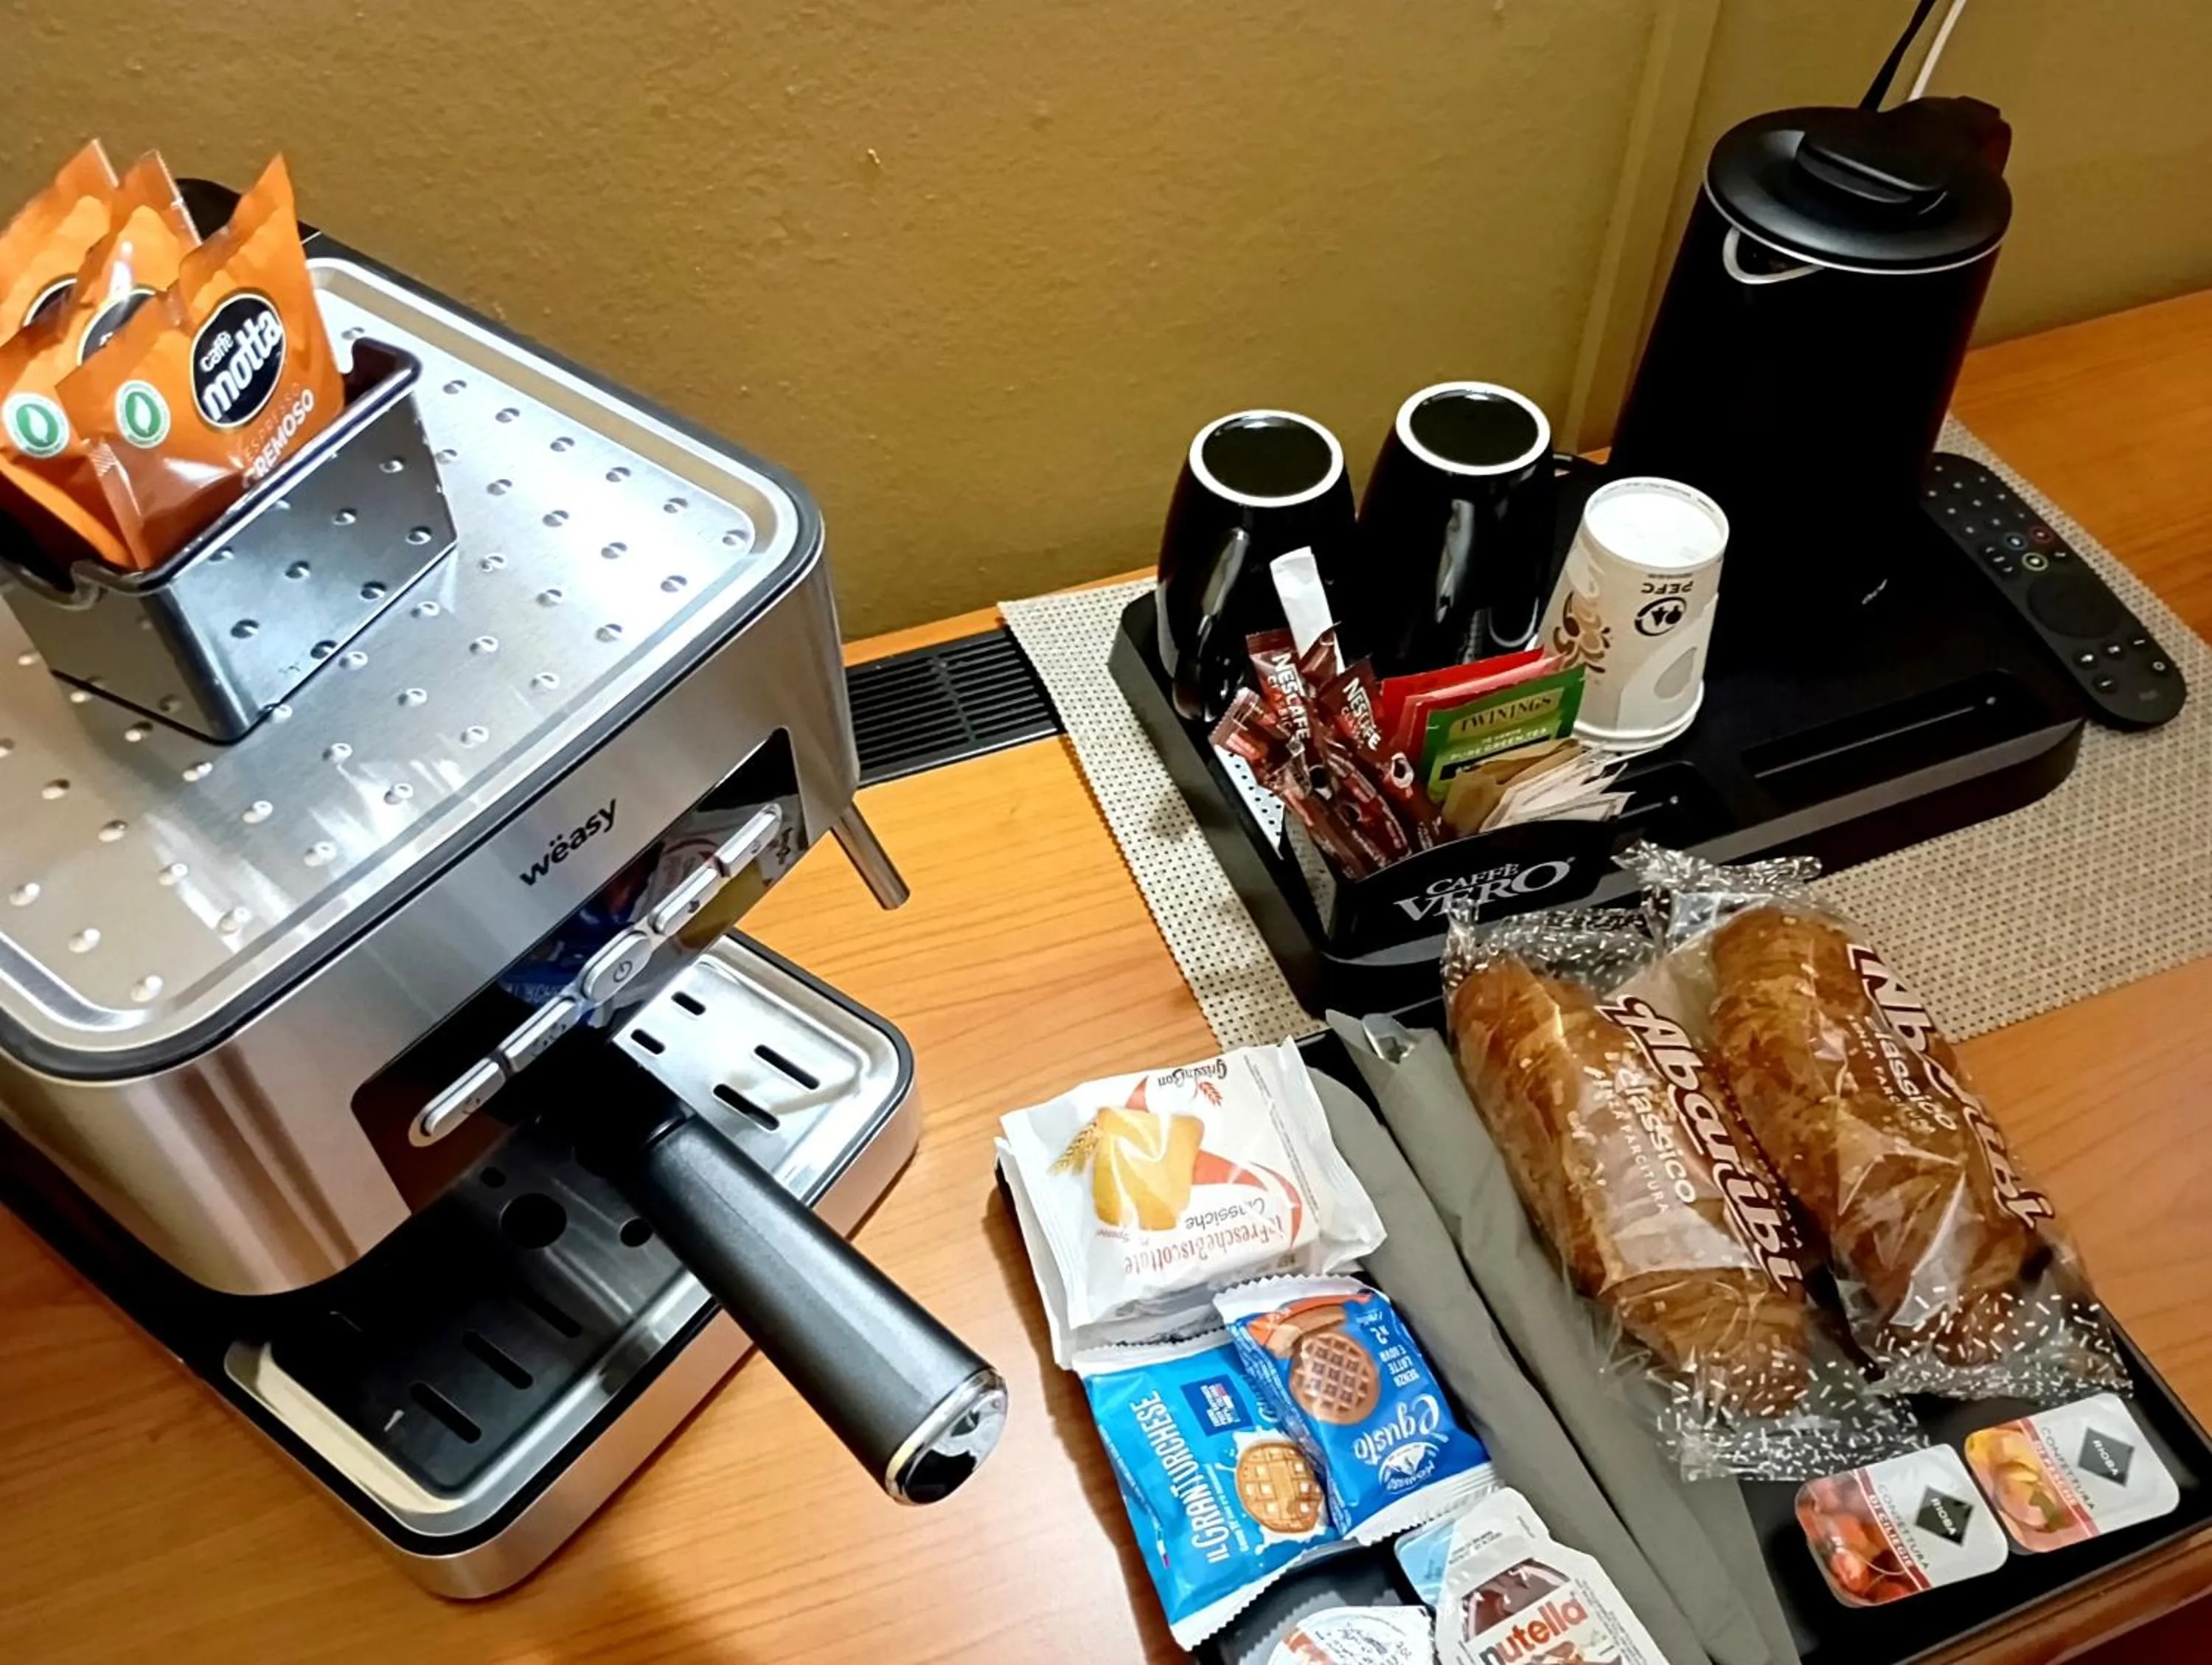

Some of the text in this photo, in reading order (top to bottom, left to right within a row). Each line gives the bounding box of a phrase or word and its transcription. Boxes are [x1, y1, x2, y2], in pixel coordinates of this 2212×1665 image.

[201, 310, 284, 421] motta
[1641, 580, 1694, 595] PEFC
[1461, 697, 1553, 731] TWININGS
[519, 799, 616, 886] wëasy
[1393, 861, 1571, 921] VERO
[1595, 995, 1804, 1293] Abaribi
[1617, 1067, 1697, 1203] classico
[1130, 1390, 1231, 1549] GRANTURCHESE
[2041, 1427, 2096, 1510] CONFETTURA
[2093, 1439, 2119, 1476] RIOBA
[1206, 1543, 1231, 1563] IL
[1878, 1484, 1930, 1569] CONFETTURA
[1930, 1498, 1957, 1536] RIOBA
[1478, 1597, 1589, 1665] nutella
